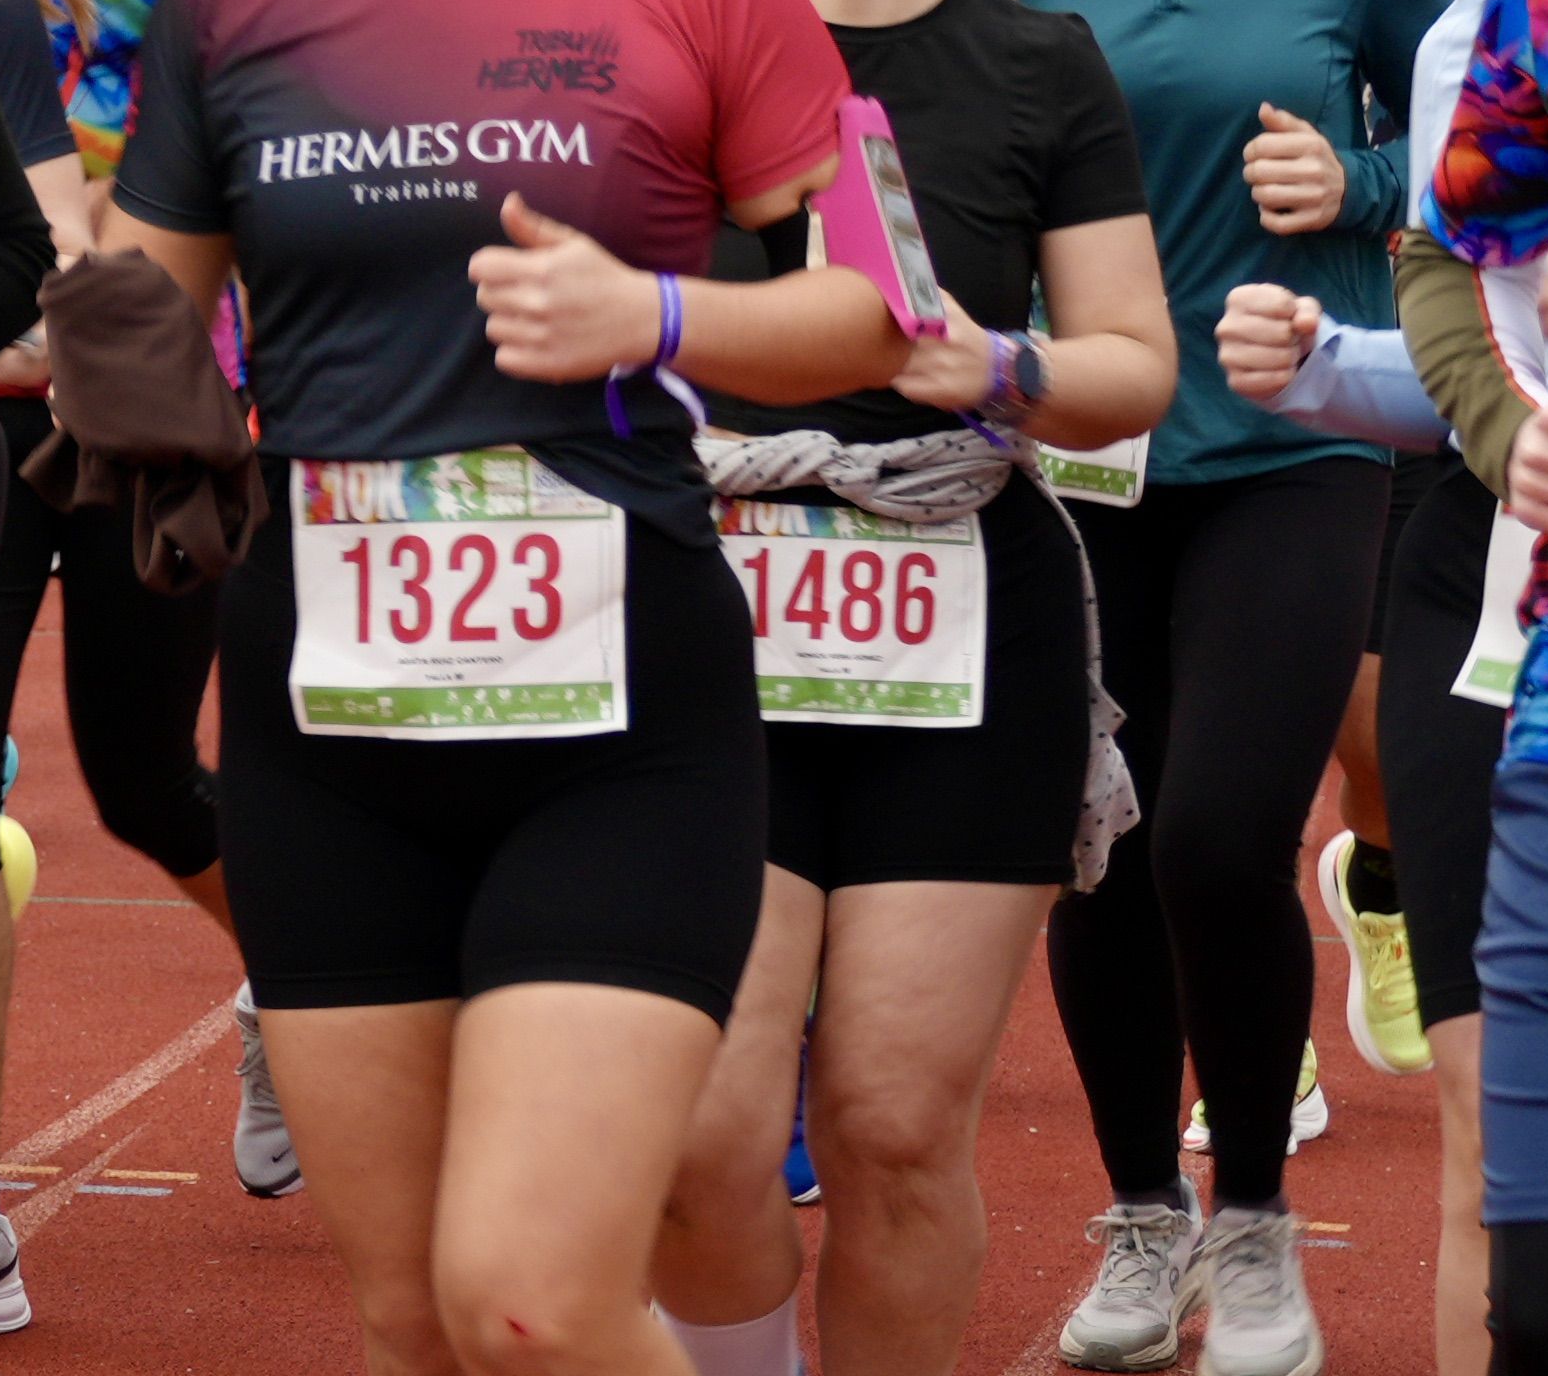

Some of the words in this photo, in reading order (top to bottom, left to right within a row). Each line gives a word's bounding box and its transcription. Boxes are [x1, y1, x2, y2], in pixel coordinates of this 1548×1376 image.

[478, 56, 619, 94] HERMES
[257, 121, 460, 184] HERMES
[466, 119, 594, 167] GYM
[349, 177, 479, 206] Training
[341, 533, 564, 645] 1323
[743, 546, 939, 646] 1486
